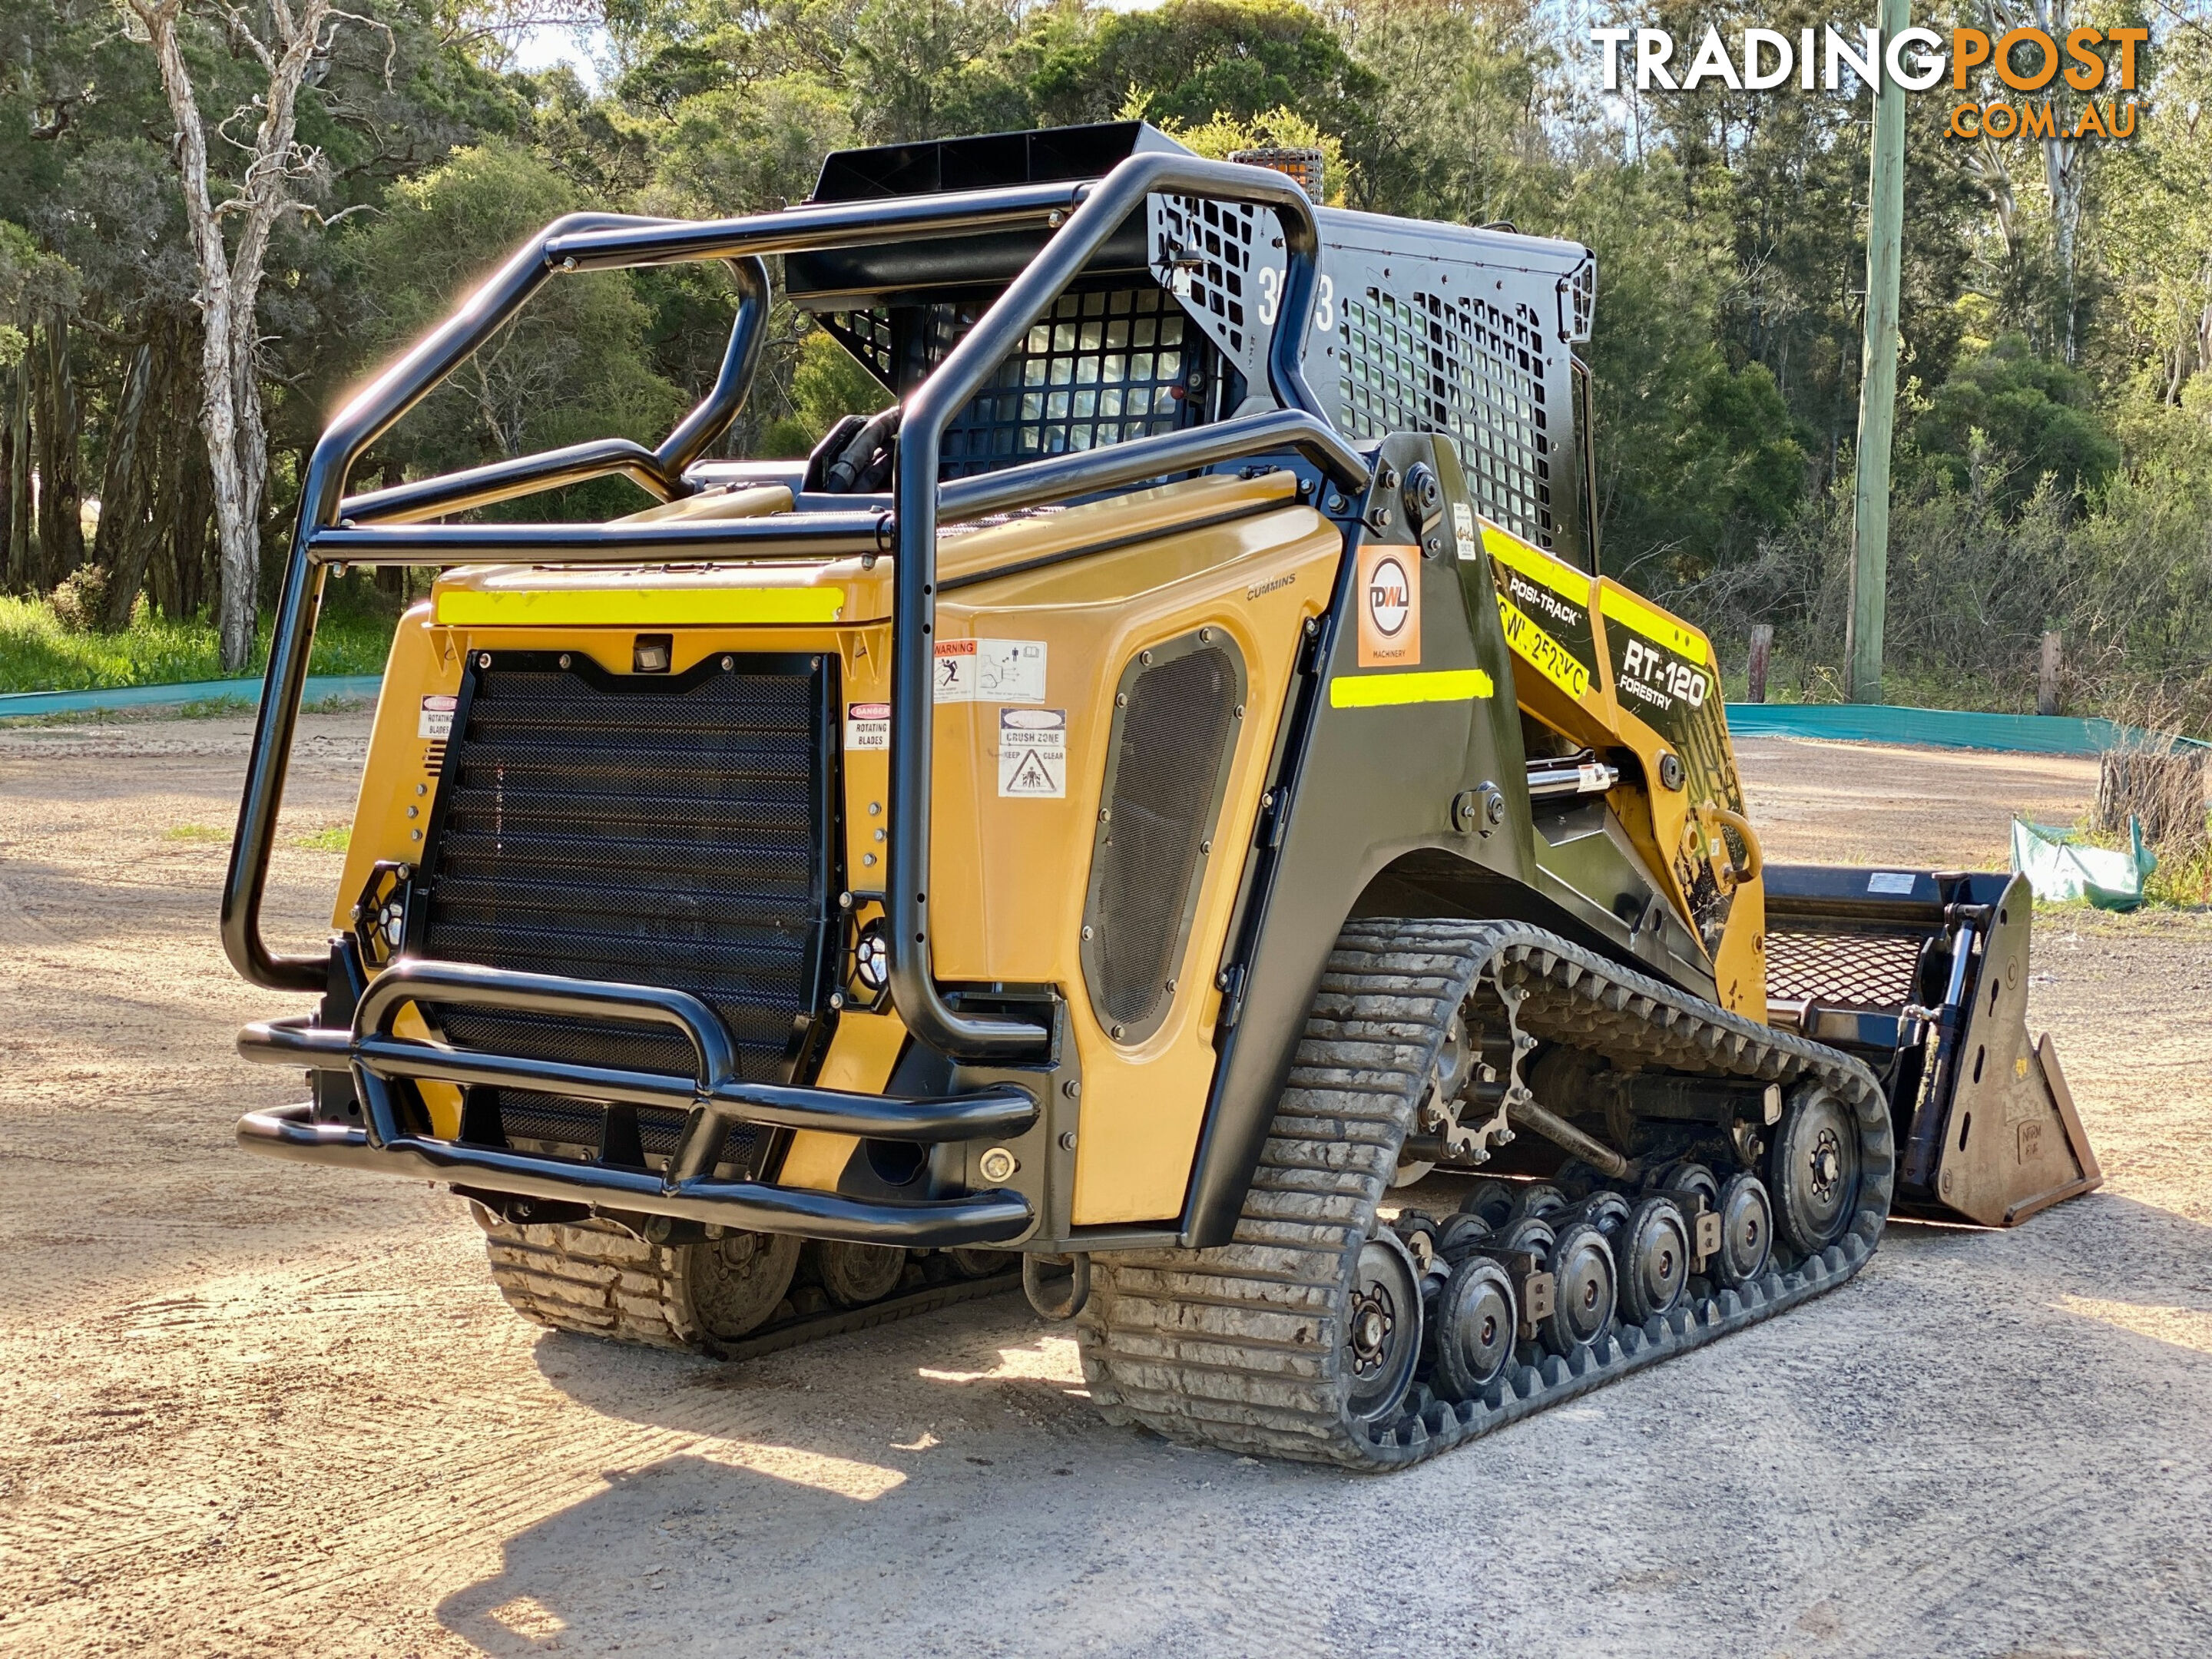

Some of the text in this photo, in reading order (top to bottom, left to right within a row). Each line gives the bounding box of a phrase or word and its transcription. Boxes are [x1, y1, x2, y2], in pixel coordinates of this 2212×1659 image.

[1247, 573, 1296, 601] CUMMINS
[1509, 578, 1576, 626] POSI-TRACK
[934, 643, 973, 654] WARNING
[1373, 650, 1406, 658] MACHINERY
[1624, 638, 1706, 707] RT-120
[1620, 674, 1672, 710] FORESTRY
[859, 736, 882, 744] BLADES
[1006, 733, 1059, 743] CRUSH ZONE
